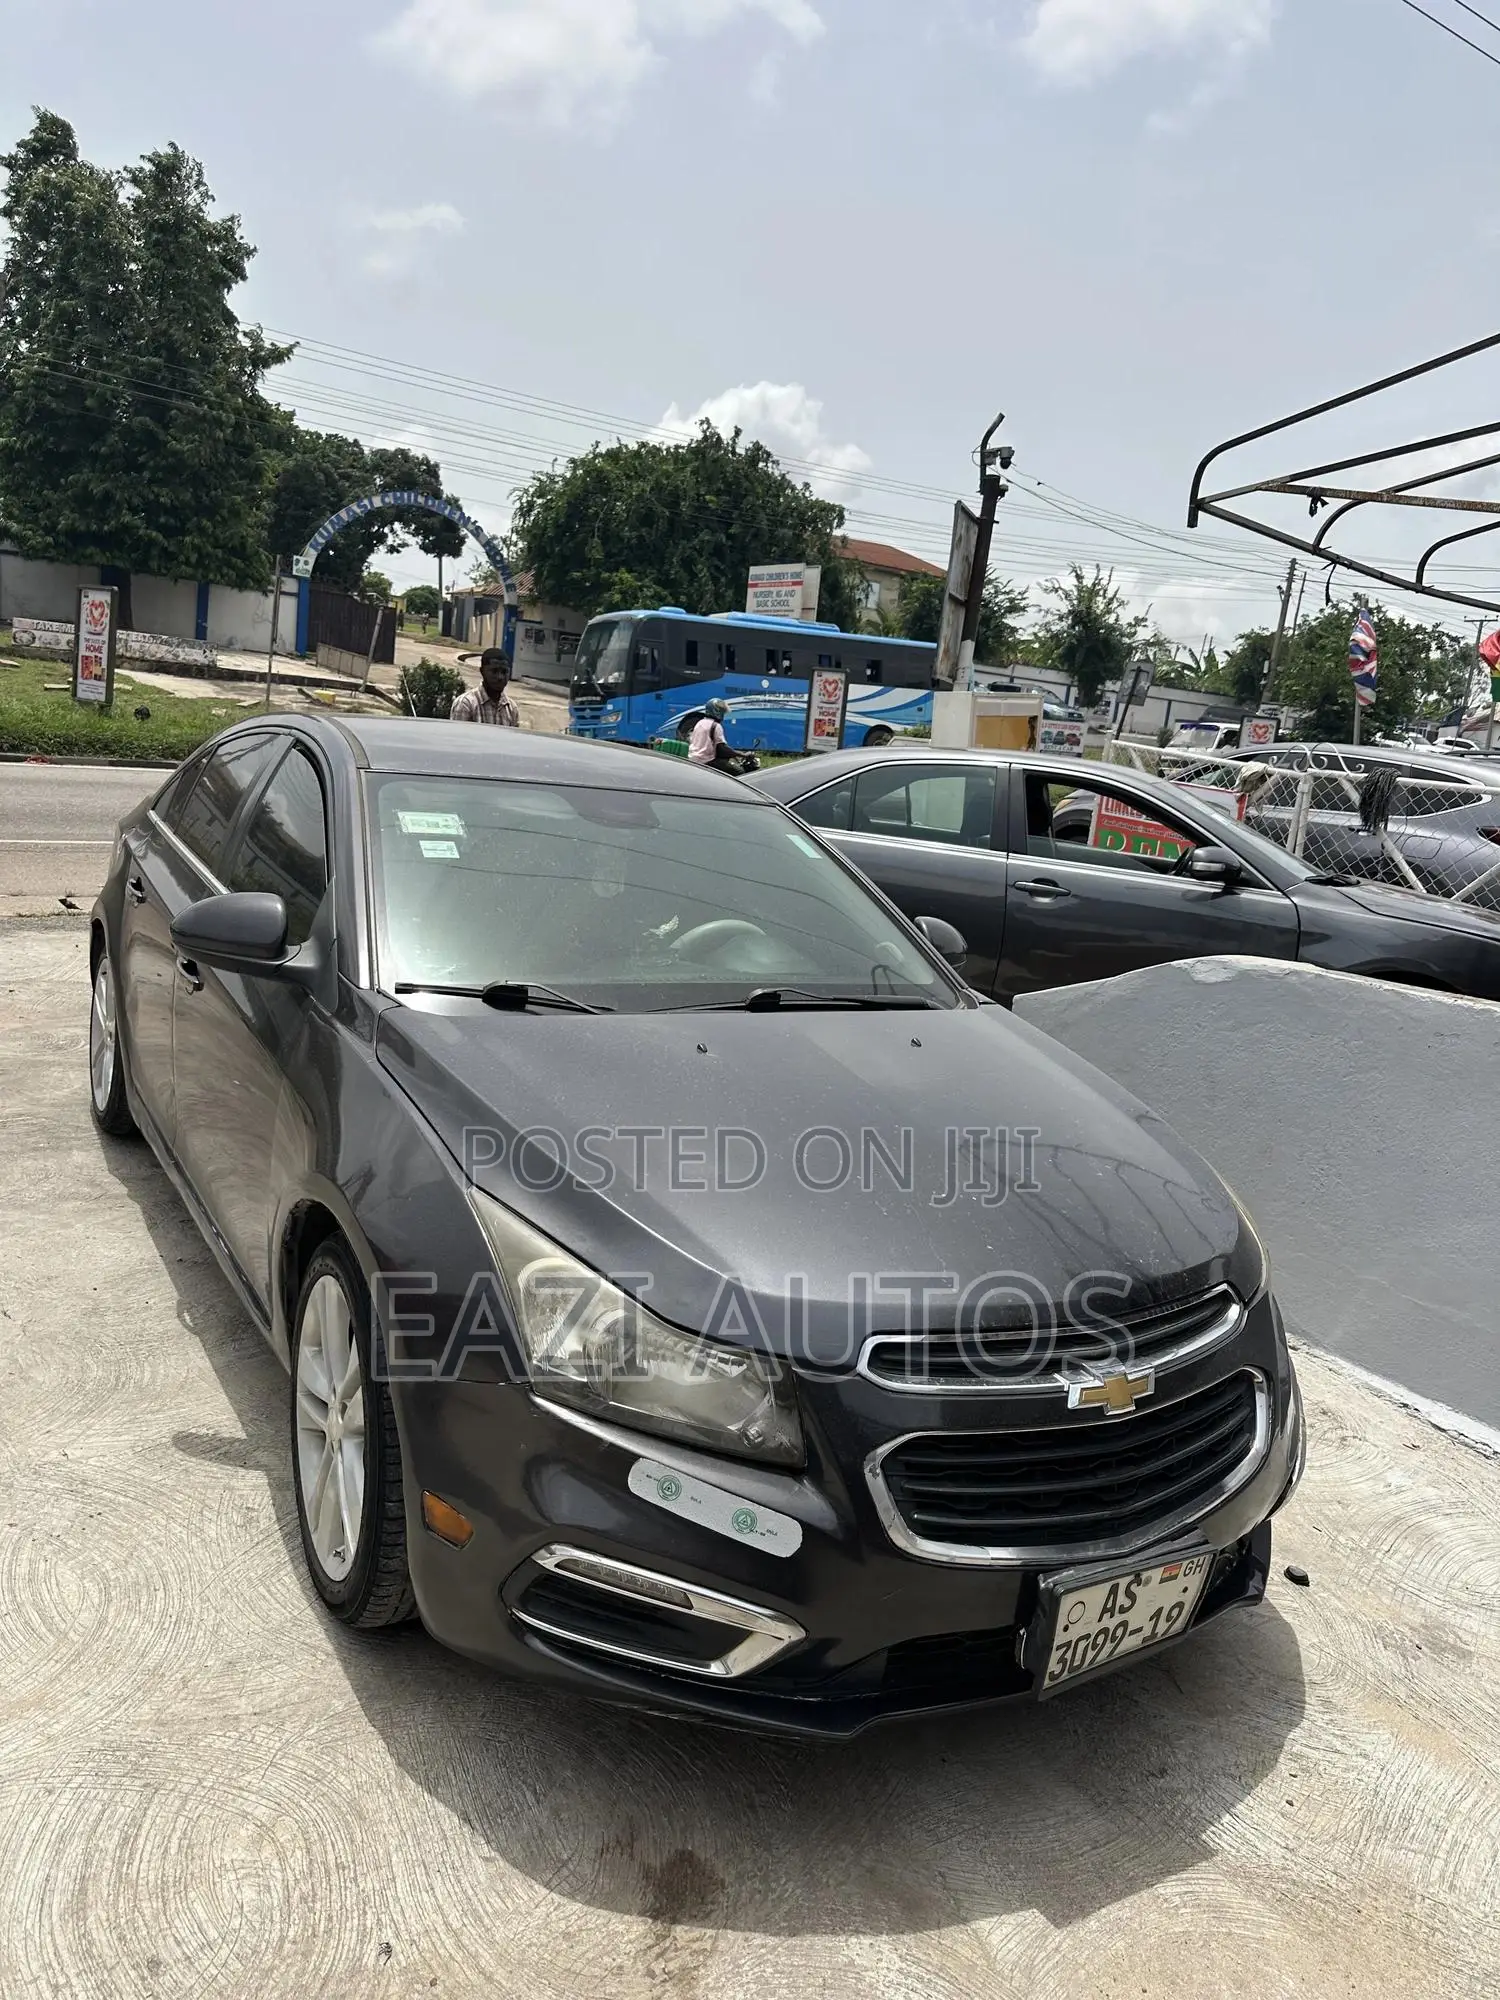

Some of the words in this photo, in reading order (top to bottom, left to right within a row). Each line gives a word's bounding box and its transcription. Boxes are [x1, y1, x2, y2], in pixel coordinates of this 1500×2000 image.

[309, 496, 375, 553] KUMASI
[85, 644, 104, 654] HOME
[1183, 1556, 1207, 1578] GH
[1097, 1576, 1143, 1623] AS
[1047, 1600, 1186, 1682] 3099-19
